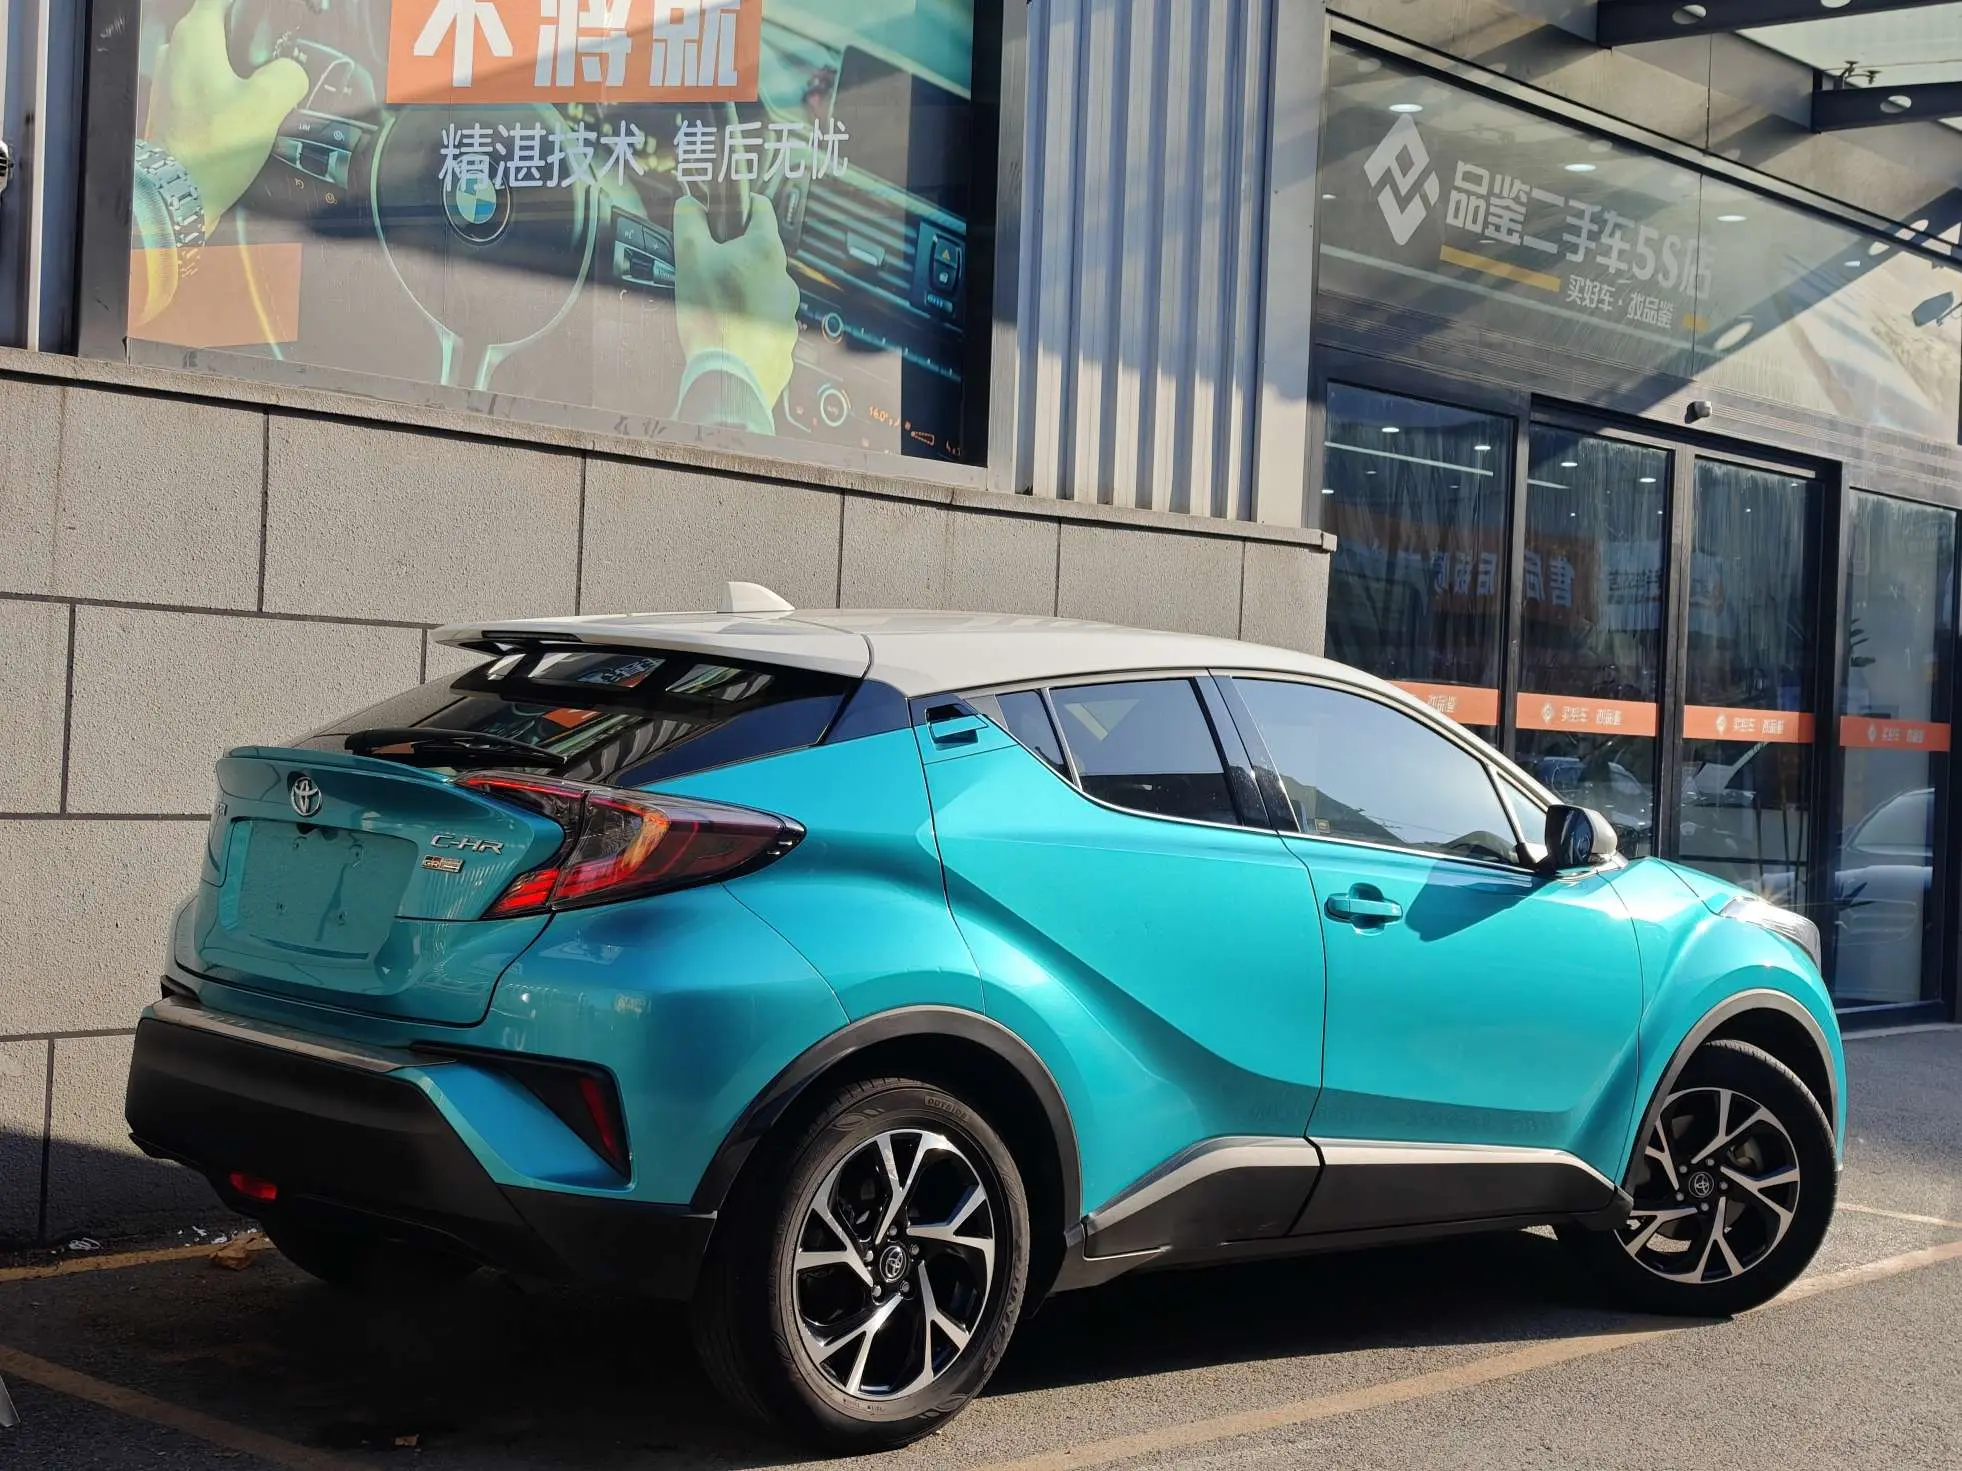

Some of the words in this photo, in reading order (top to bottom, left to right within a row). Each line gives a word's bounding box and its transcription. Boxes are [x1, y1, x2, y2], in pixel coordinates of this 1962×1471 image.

[439, 119, 646, 191] 精湛技术
[673, 118, 849, 184] 售后无忧
[1445, 161, 1716, 299] 品鉴二手车5S店
[430, 835, 504, 855] C-HR
